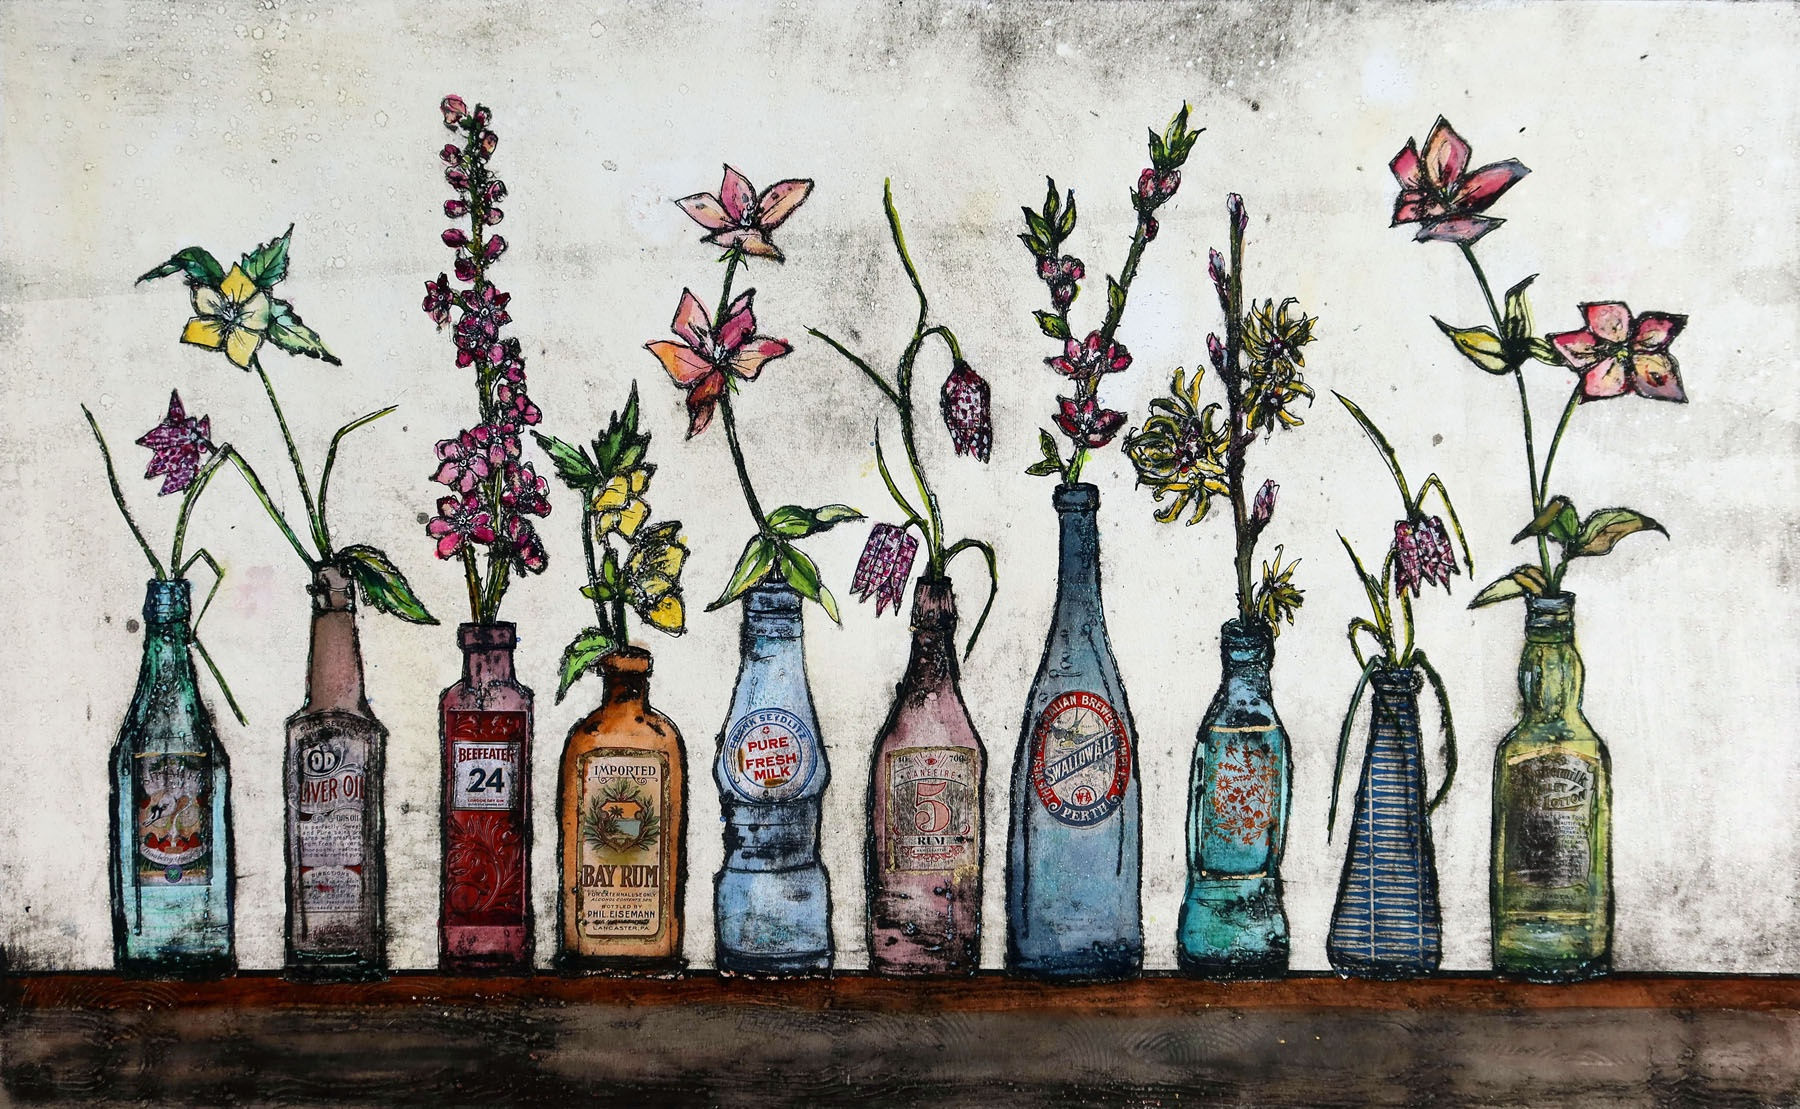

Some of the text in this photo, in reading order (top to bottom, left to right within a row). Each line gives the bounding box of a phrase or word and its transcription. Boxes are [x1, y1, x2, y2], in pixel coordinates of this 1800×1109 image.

[729, 713, 807, 749] FRANK SEYDLITZ
[747, 736, 789, 753] PURE
[458, 747, 516, 763] BEEFEATER
[745, 752, 797, 770] FRESH
[466, 767, 505, 793] 24
[594, 764, 656, 779] IMPORTED
[753, 766, 791, 781] MILK
[301, 775, 366, 803] LIVER OIL
[914, 781, 950, 833] 5
[1541, 788, 1587, 811] LOTION
[1061, 801, 1110, 822] PERTH
[917, 836, 946, 846] RUM
[582, 864, 659, 888] BAY RUM
[609, 910, 656, 919] EISEMANN
